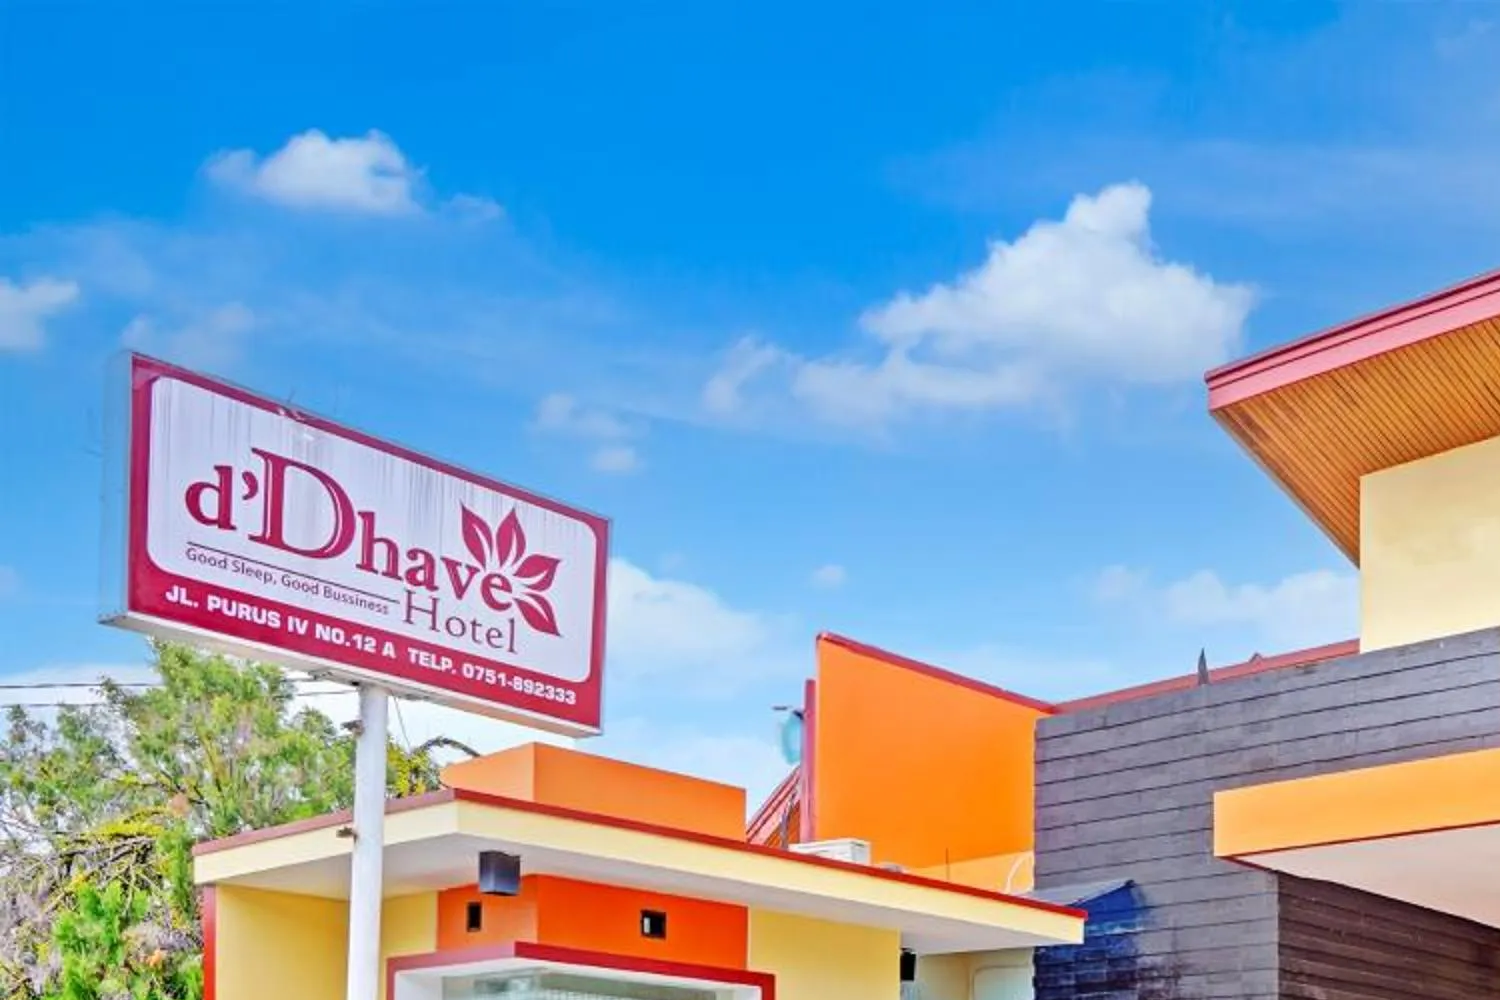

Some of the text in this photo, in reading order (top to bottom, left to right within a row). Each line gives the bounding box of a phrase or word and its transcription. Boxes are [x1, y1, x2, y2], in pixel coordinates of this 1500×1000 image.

[185, 447, 514, 611] d'Dhave
[186, 548, 390, 615] Good Sleep, Good Bussiness
[403, 588, 518, 655] Hotel
[165, 585, 577, 705] JL. PURUS IV NO.12 A TELP. 0751-892333
